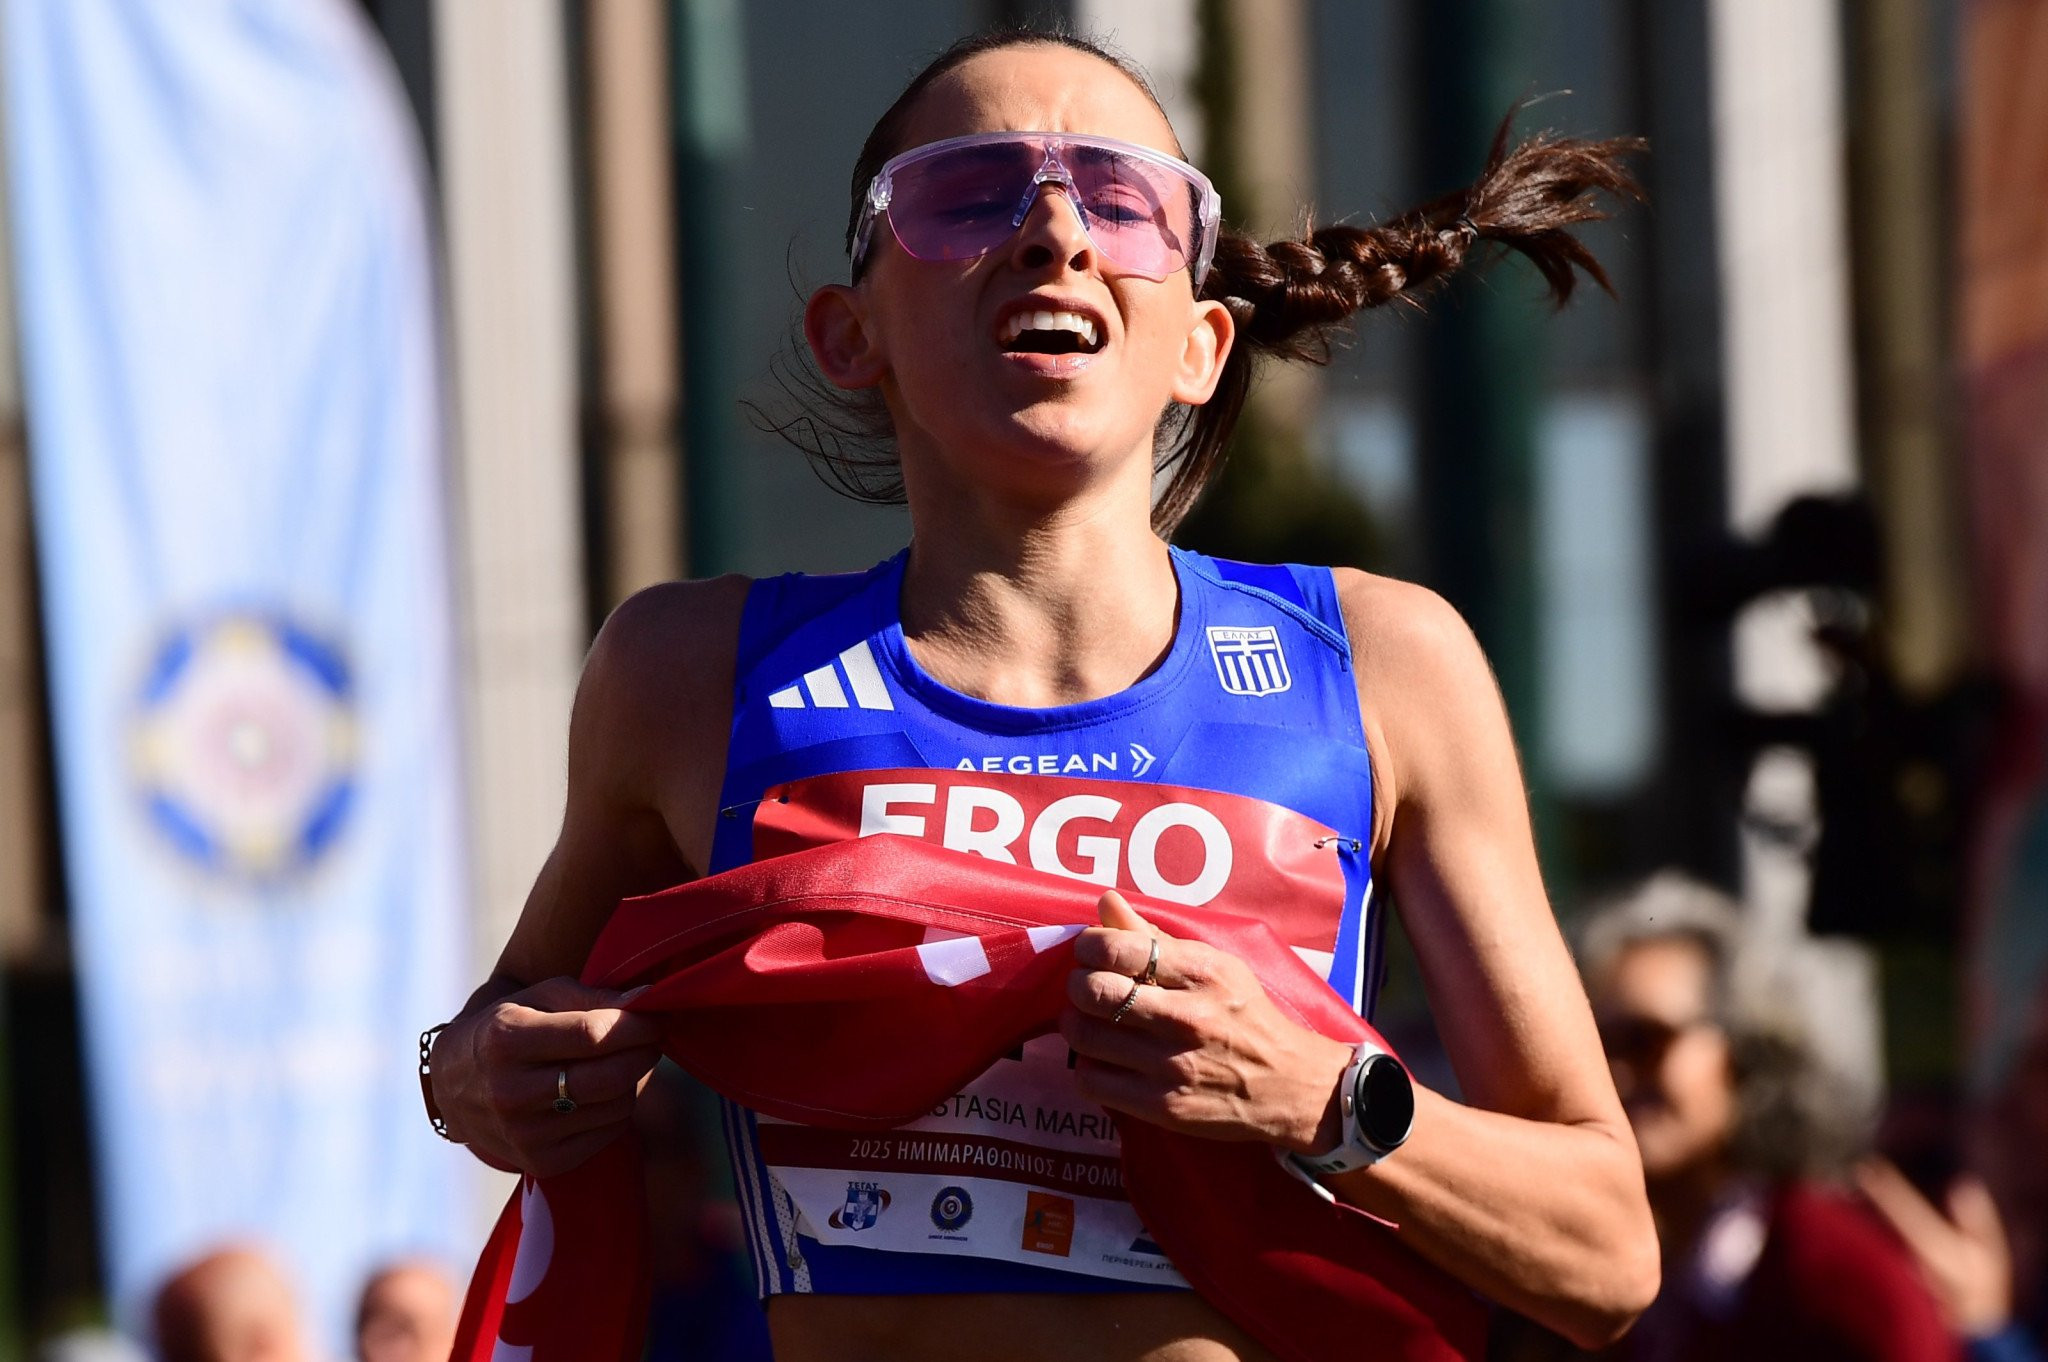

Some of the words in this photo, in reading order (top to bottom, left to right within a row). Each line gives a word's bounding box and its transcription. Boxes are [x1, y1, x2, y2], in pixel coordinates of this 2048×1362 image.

[956, 752, 1117, 774] AEGEAN
[928, 1094, 1027, 1129] STASIA
[849, 1139, 892, 1159] 2025
